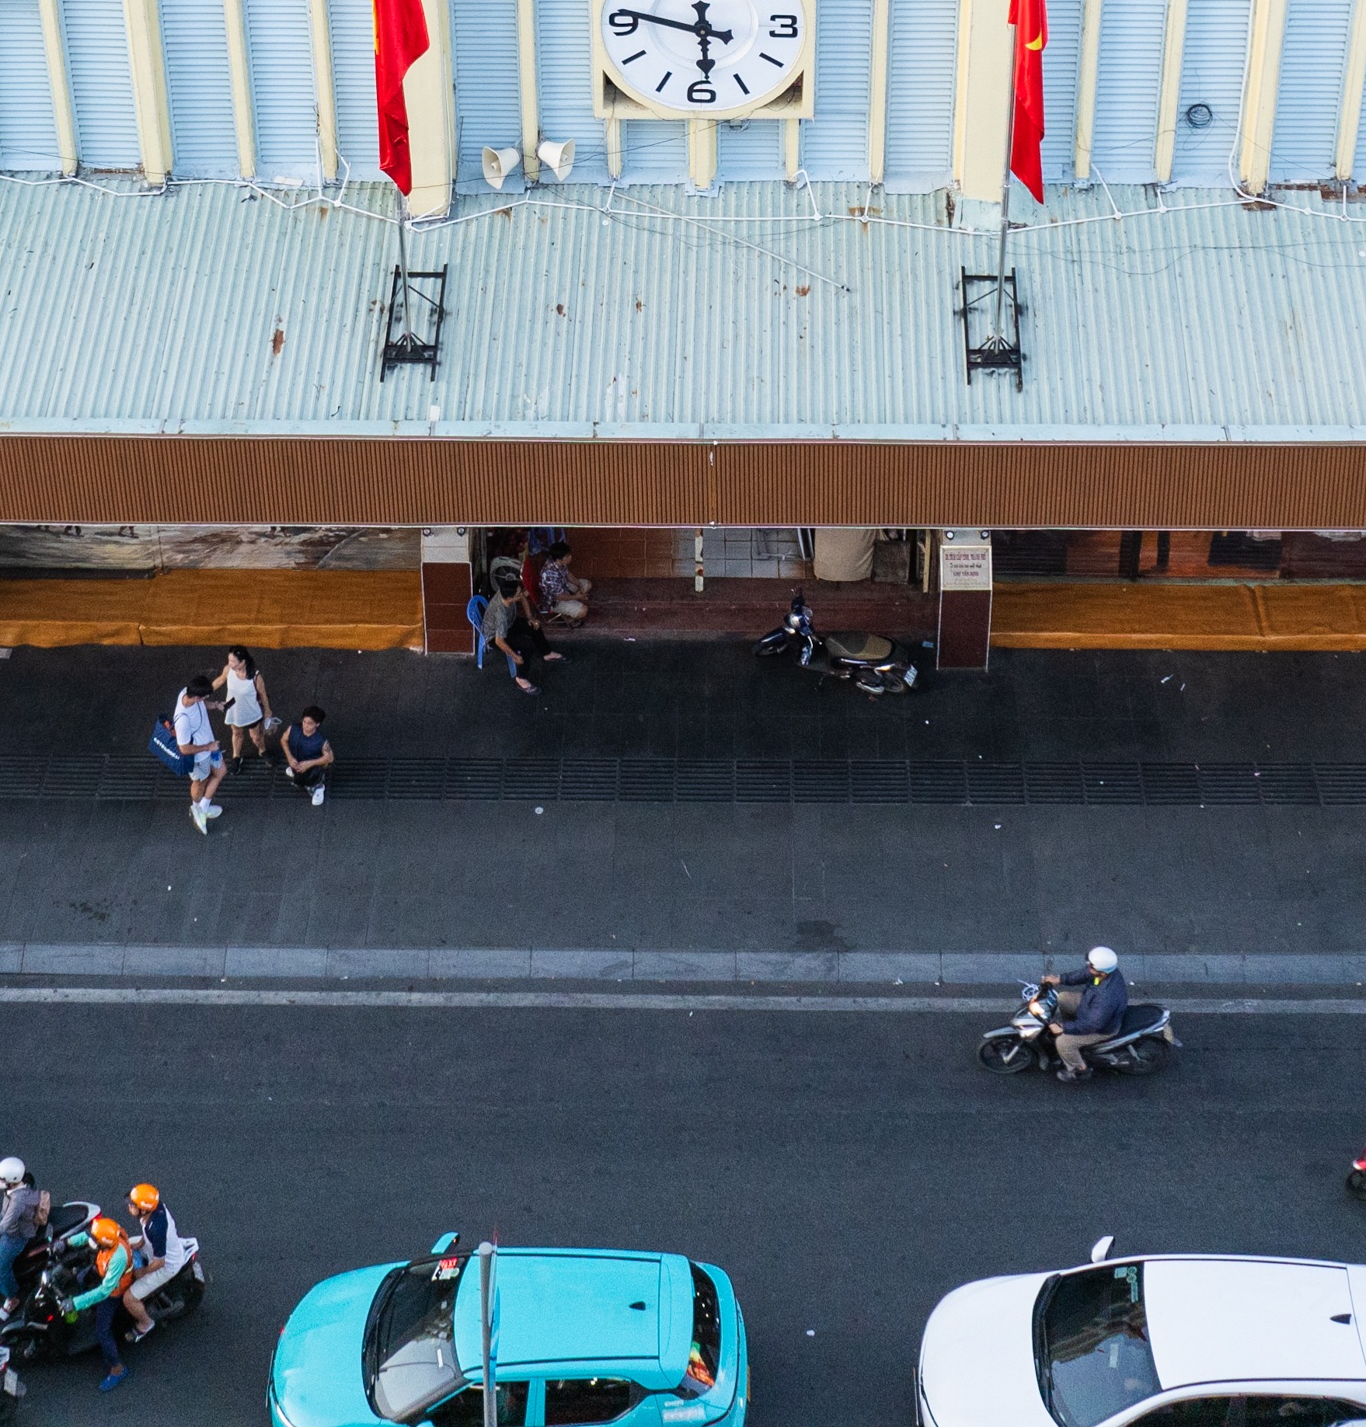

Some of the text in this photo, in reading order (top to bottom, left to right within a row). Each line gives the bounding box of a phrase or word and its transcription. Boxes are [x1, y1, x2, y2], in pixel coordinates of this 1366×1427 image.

[609, 12, 639, 36] 9
[769, 15, 798, 38] 3
[687, 80, 716, 103] 6
